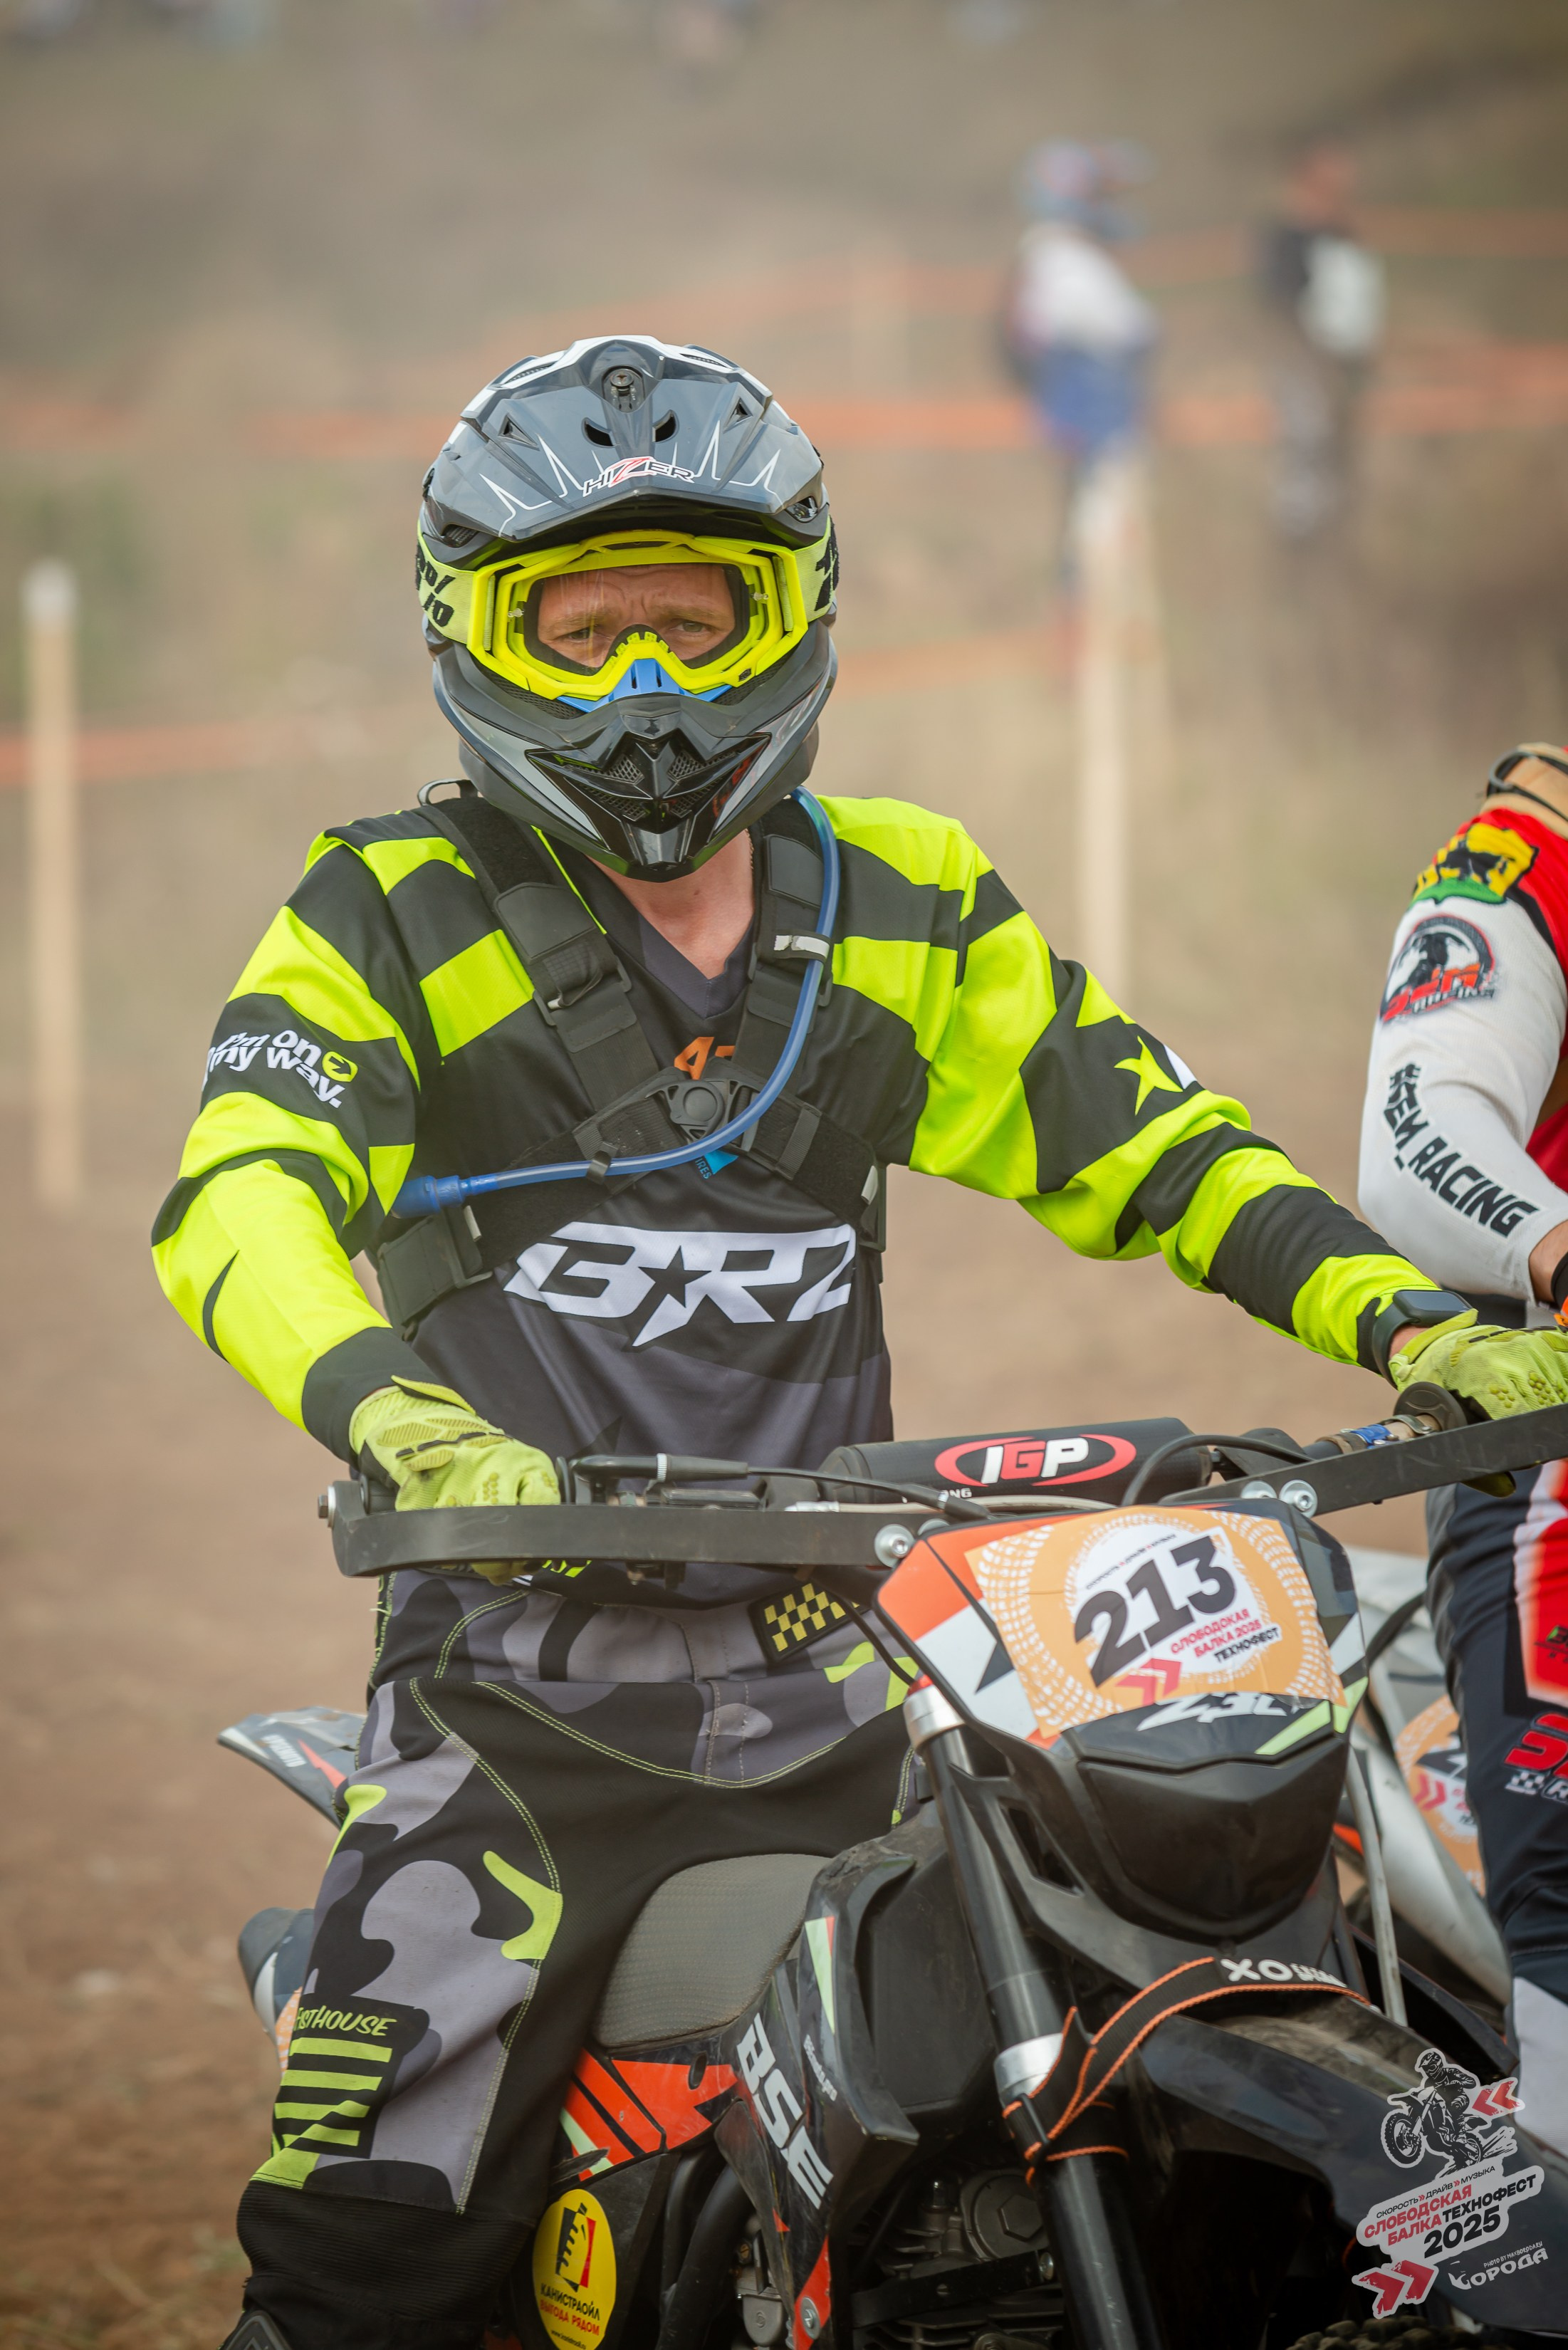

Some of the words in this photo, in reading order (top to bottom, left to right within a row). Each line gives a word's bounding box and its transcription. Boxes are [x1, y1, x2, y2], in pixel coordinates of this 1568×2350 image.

[582, 456, 695, 497] HIZER
[272, 1030, 322, 1067] on
[981, 1437, 1089, 1484] IGP
[1075, 1535, 1235, 1688] 213
[1171, 1609, 1250, 1654] СЛОБОДСКАЯ
[1194, 1630, 1235, 1658] БАЛКА
[1214, 1626, 1280, 1664] ТЕХНОФЕСТ
[736, 2012, 834, 2210] BSE
